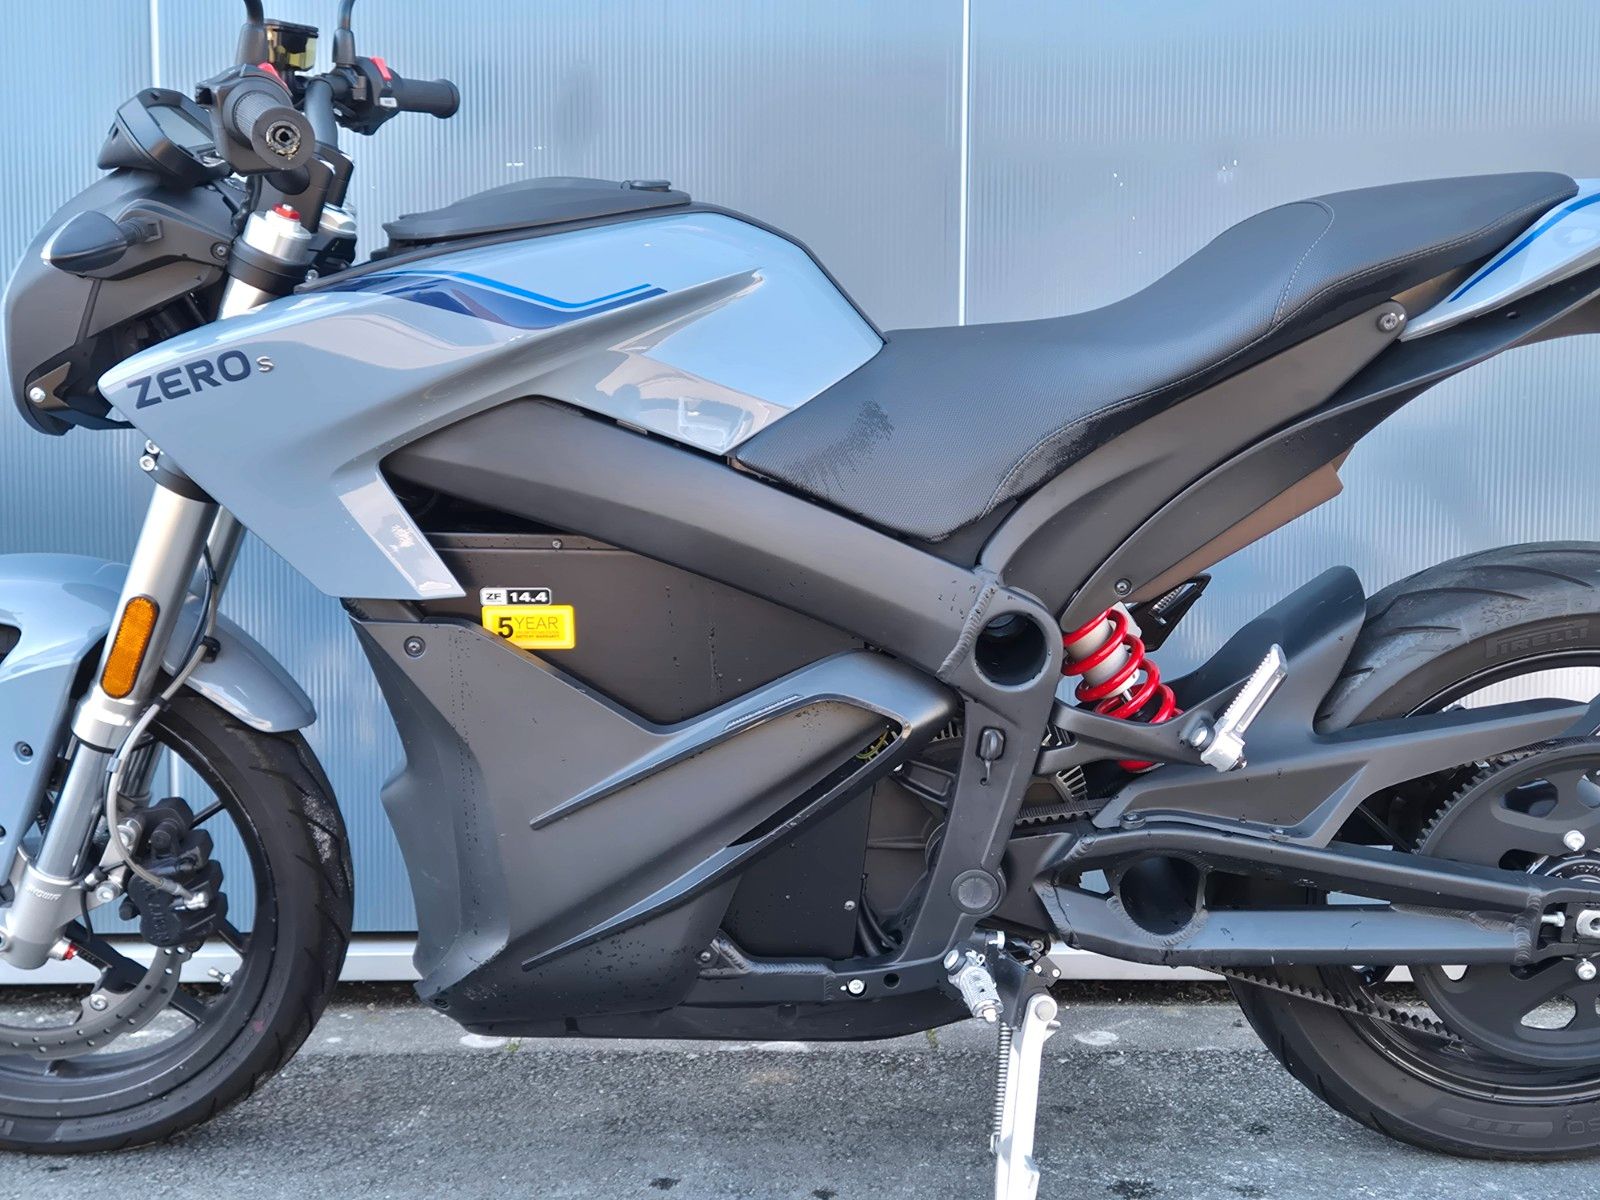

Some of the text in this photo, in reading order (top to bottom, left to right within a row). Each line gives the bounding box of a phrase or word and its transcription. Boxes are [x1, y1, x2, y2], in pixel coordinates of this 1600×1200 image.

[127, 350, 275, 410] ZERO S
[509, 592, 548, 602] 14.4
[498, 616, 558, 639] 5 YEAR
[1485, 619, 1589, 659] PIRELLI
